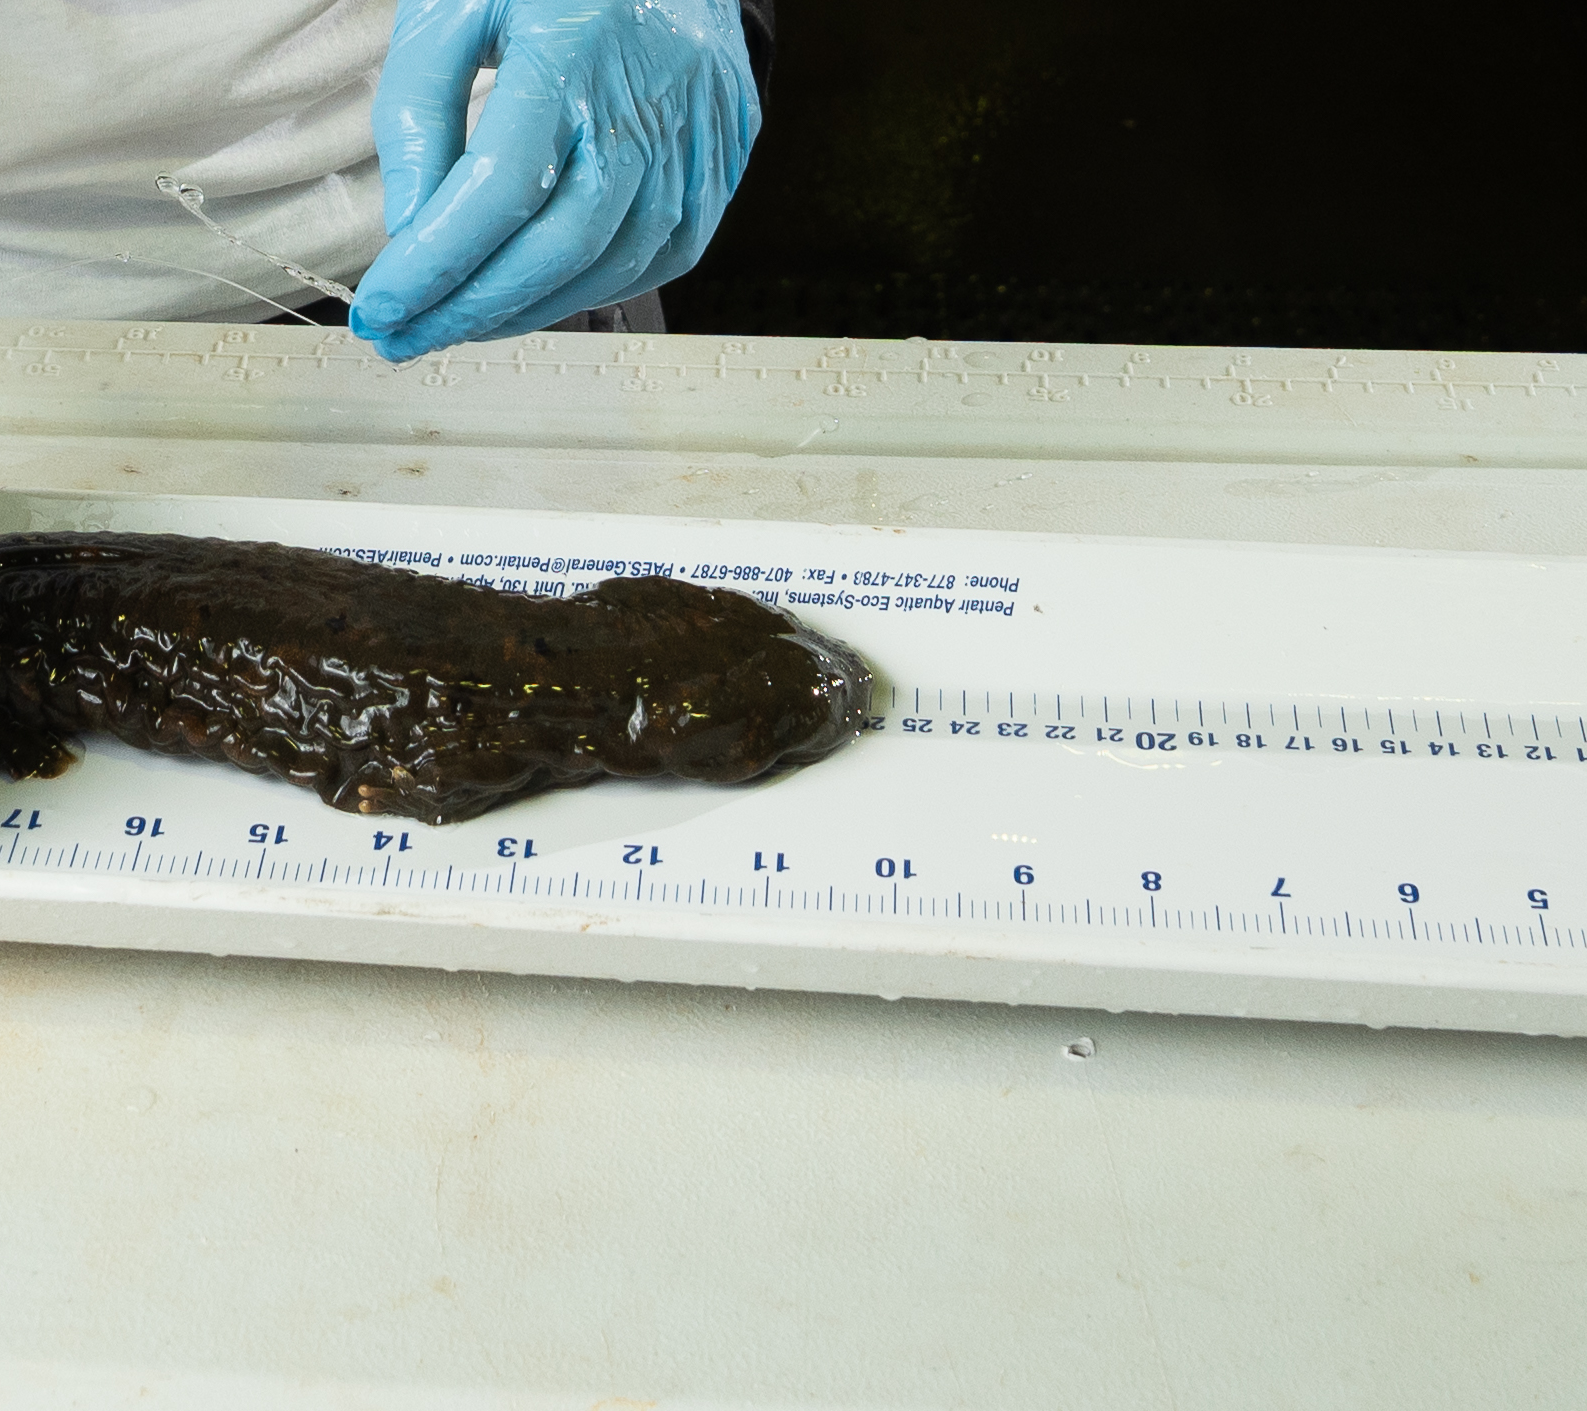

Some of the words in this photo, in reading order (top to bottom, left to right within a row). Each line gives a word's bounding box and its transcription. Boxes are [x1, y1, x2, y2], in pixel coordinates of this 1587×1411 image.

[460, 553, 674, 579] PAES.General@Pentair.com
[691, 564, 793, 582] 407-886-6787
[802, 569, 835, 584] Fax:
[965, 576, 1019, 592] Phone:
[534, 580, 565, 599] Unit
[785, 589, 890, 611] Eco-Systems,
[895, 594, 955, 613] Aquatic
[958, 600, 1014, 616] Pentair
[902, 718, 932, 733] 25
[950, 721, 980, 735] 24
[997, 723, 1028, 737] 23
[1045, 725, 1076, 740] 22
[1097, 728, 1124, 742] 21
[1136, 732, 1177, 751] 20
[1188, 732, 1219, 746] 19
[1236, 734, 1267, 748] 18
[1285, 736, 1315, 750] 17
[1332, 738, 1363, 752] 16
[1380, 740, 1412, 754] 15
[1428, 742, 1460, 756] 14
[1476, 744, 1508, 758] 13
[1524, 746, 1557, 760] 12
[0, 809, 42, 830] 17
[125, 816, 164, 837] 16
[248, 824, 288, 844] 15
[373, 831, 412, 852] 14
[497, 838, 538, 858] 13
[623, 845, 663, 865] 12
[754, 852, 790, 872] 11
[875, 858, 917, 879] 10
[1014, 865, 1034, 885] 9
[1141, 871, 1161, 891] 8
[1271, 878, 1291, 897] 7
[1398, 883, 1419, 903] 6
[1527, 889, 1549, 909] 5
